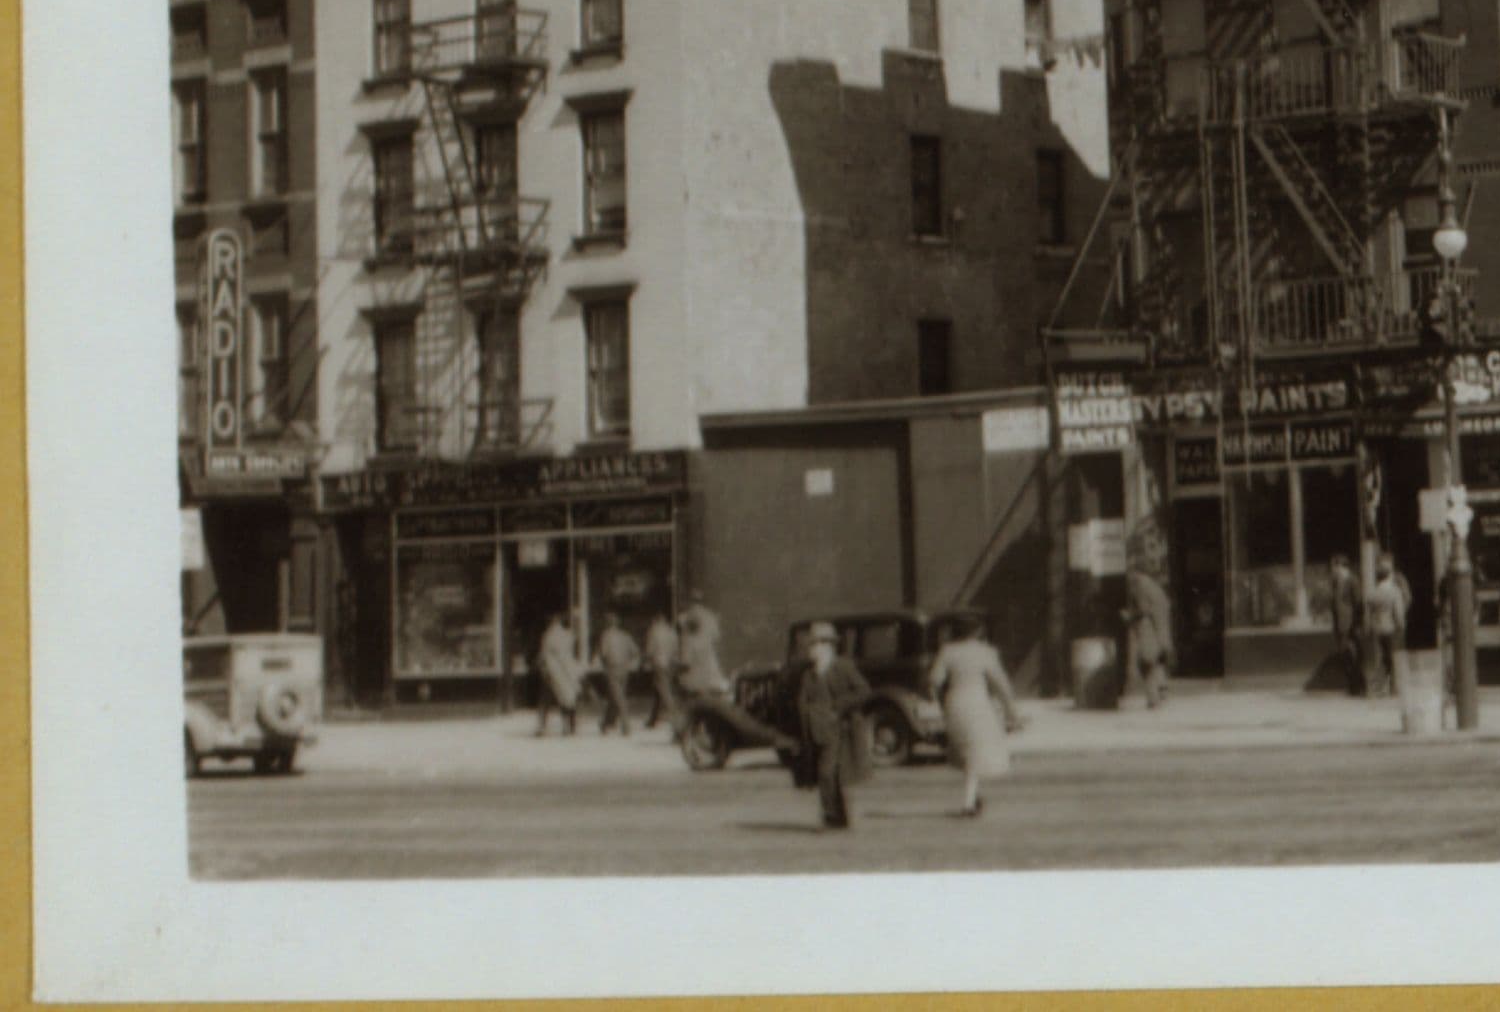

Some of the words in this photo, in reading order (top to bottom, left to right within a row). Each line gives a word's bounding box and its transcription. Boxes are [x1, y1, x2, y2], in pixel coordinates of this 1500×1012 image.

[212, 240, 238, 440] RADIO
[1058, 372, 1124, 396] DUTCH
[1240, 380, 1347, 414] PAINTS
[1058, 399, 1131, 426] MASTERS
[1062, 428, 1129, 450] PAINTS
[1295, 427, 1352, 452] PAINT
[539, 455, 669, 480] APPLIANCES
